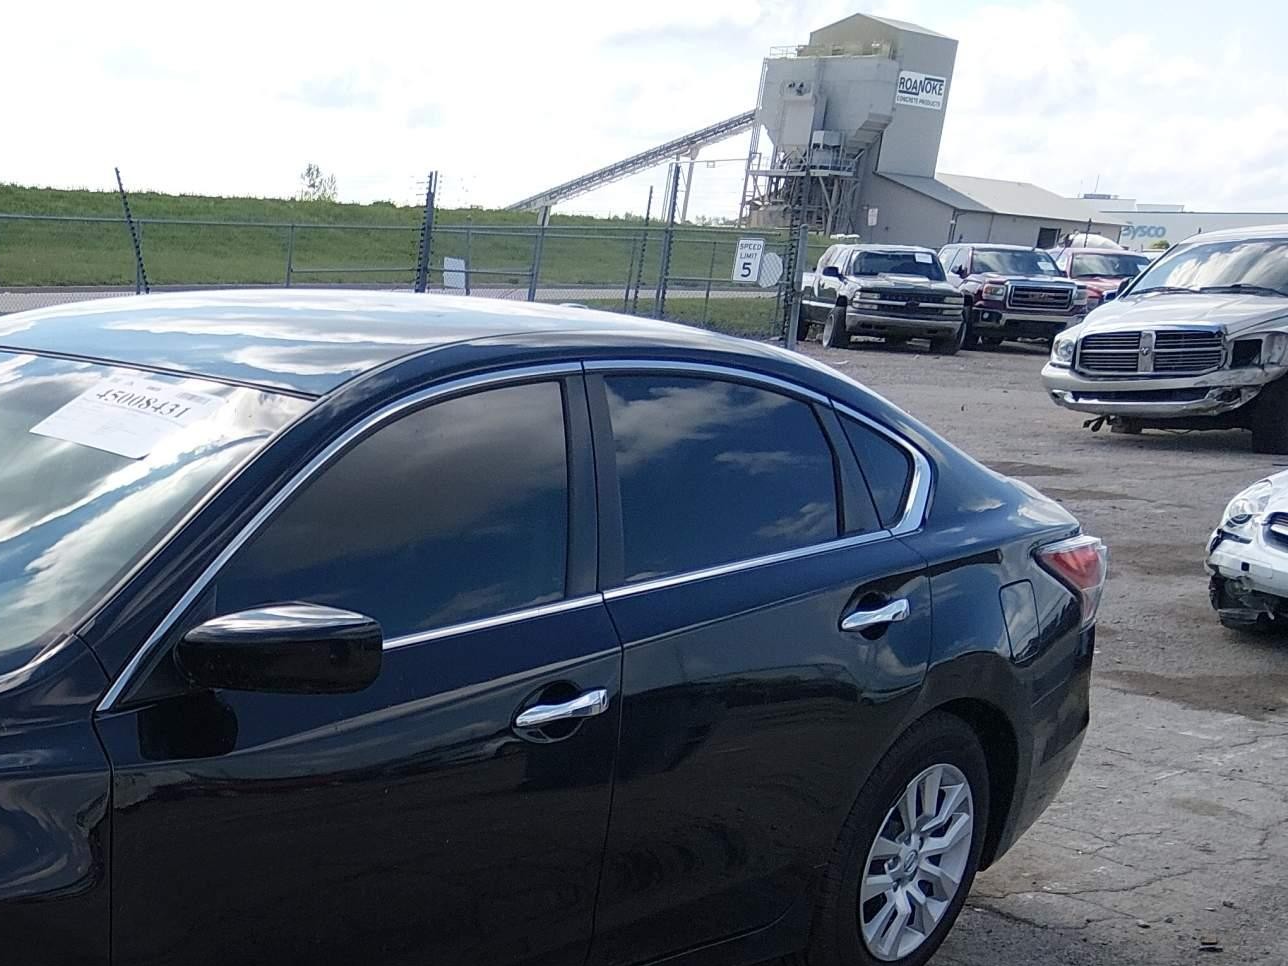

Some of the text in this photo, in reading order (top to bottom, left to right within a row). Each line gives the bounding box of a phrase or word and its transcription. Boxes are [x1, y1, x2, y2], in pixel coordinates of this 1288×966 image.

[898, 77, 944, 96] ROANOKE
[896, 95, 941, 107] CONCRETE PRODUCTS
[739, 243, 762, 251] SPEED
[739, 252, 758, 260] LIMIT
[740, 262, 752, 278] 5
[96, 388, 192, 418] 45008431
